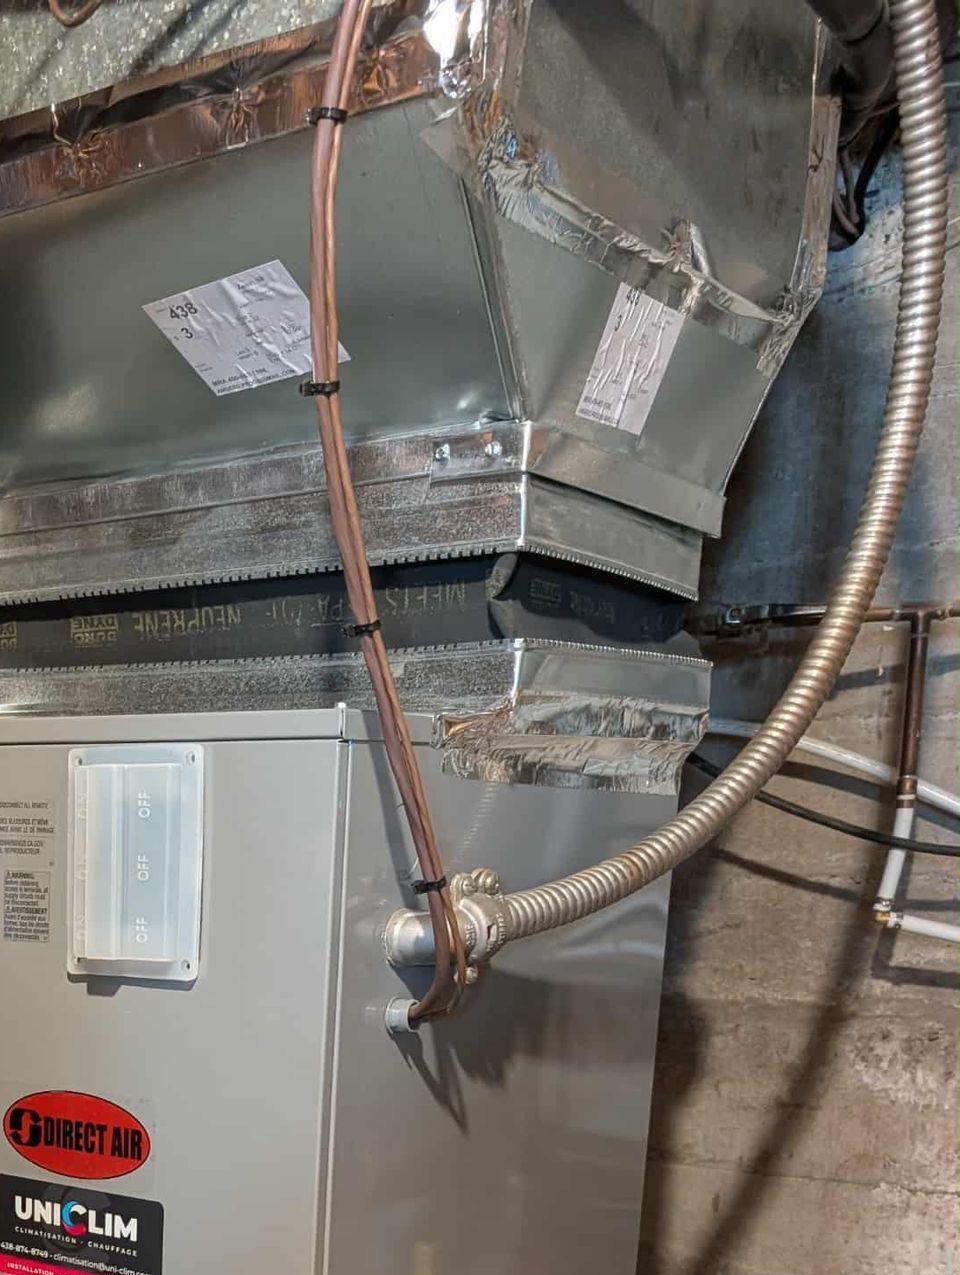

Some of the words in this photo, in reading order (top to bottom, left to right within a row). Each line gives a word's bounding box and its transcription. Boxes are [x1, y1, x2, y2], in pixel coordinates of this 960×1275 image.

[169, 302, 198, 321] 438
[181, 327, 193, 339] 3
[138, 791, 150, 818] OFF
[138, 854, 150, 881] OFF
[136, 916, 148, 944] OFF
[43, 1117, 106, 1155] DIRECT
[110, 1127, 143, 1161] AIR
[14, 1194, 138, 1243] UNICLIM
[0, 1242, 49, 1258] 438-874-8749
[14, 1226, 77, 1244] CLIMATISATION
[87, 1240, 138, 1257] CHAUFFAGE
